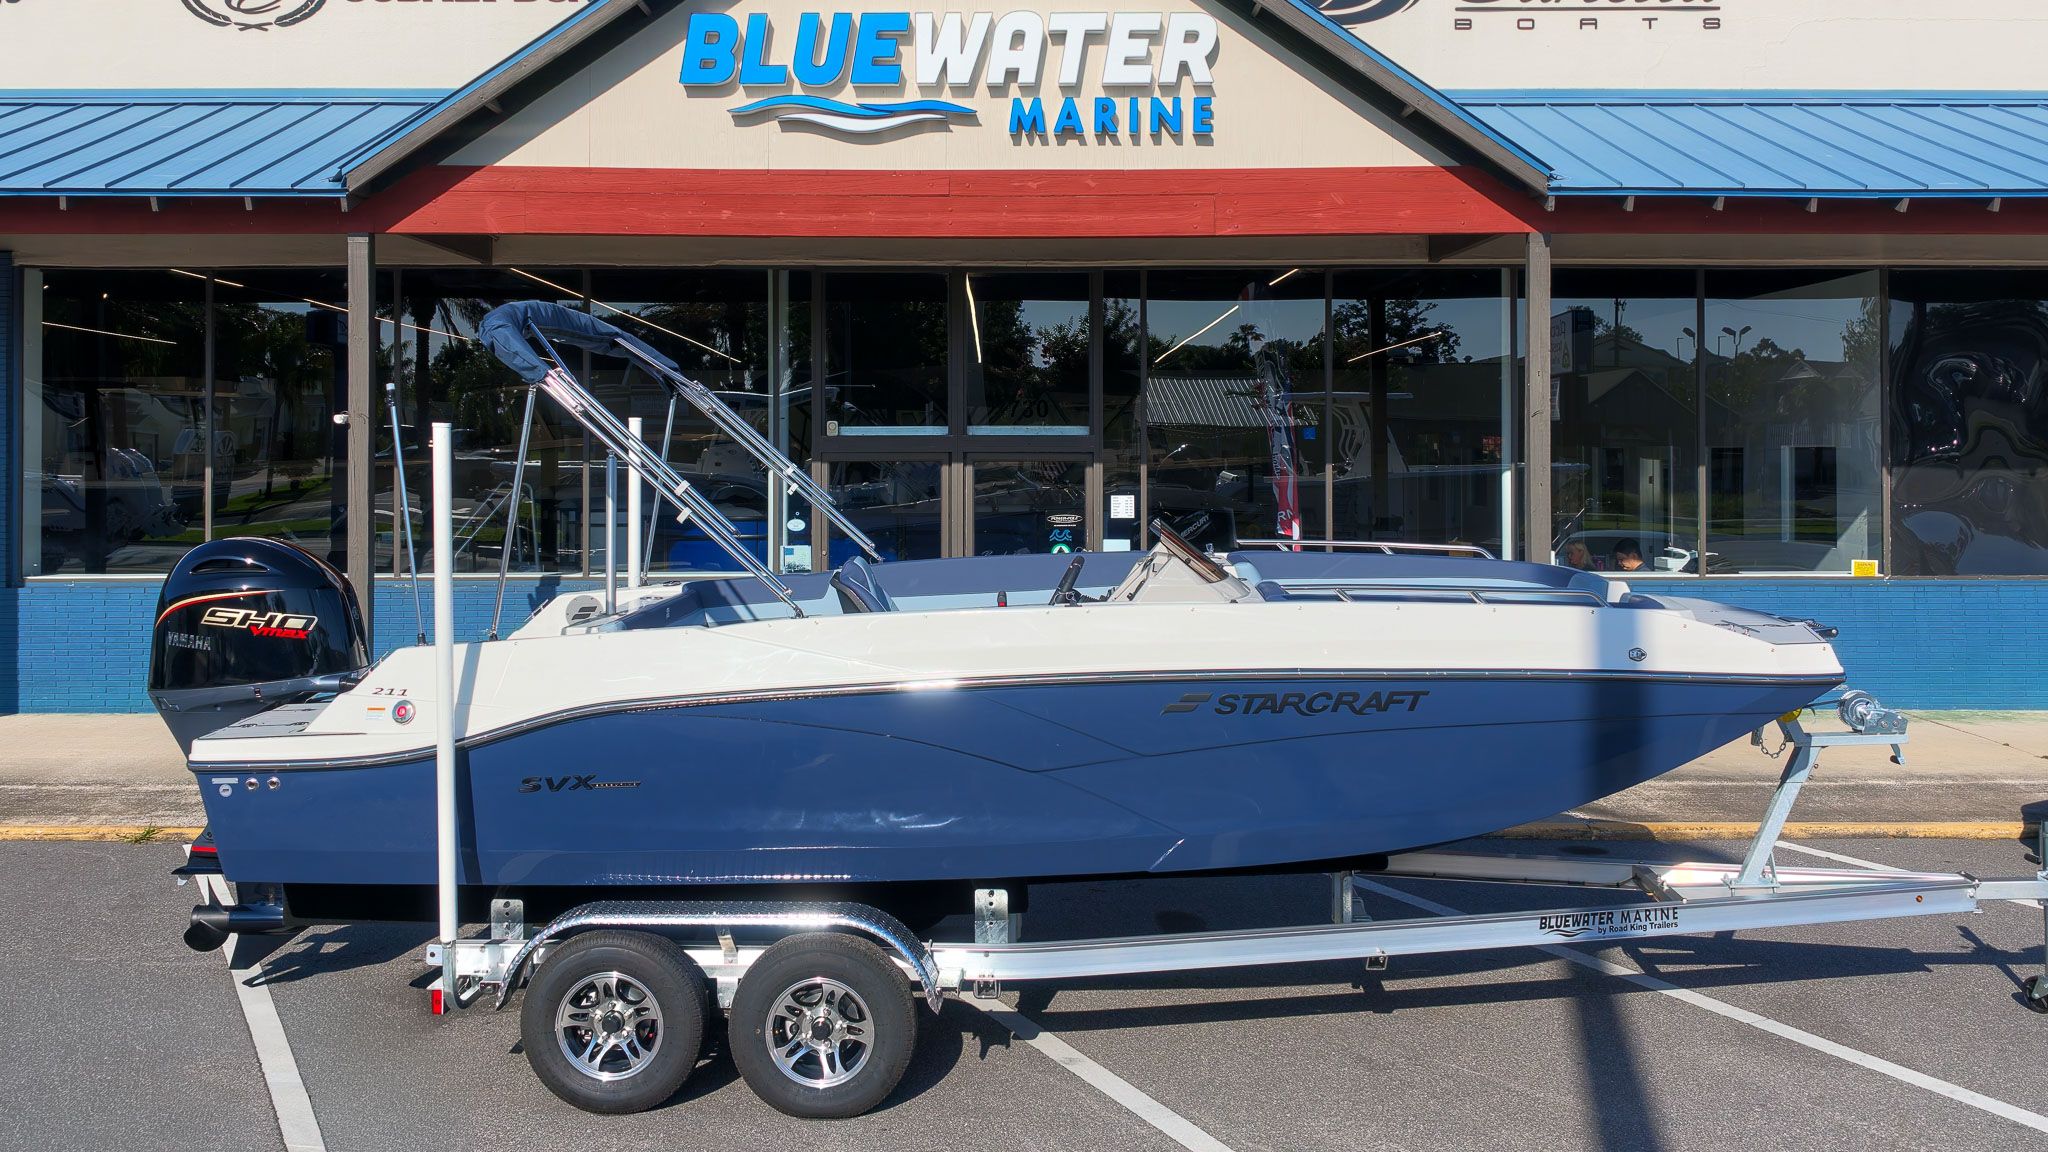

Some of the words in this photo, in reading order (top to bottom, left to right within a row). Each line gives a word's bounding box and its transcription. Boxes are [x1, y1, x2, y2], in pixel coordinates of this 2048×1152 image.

[1454, 17, 1721, 31] BOATS
[678, 12, 1219, 87] BLUEWATER
[1008, 96, 1214, 136] MARINE
[201, 607, 319, 631] SHO
[168, 631, 212, 651] YAMAHA
[372, 687, 408, 697] 211
[1214, 690, 1431, 716] STARCRAFT
[519, 775, 596, 793] SVX
[1539, 911, 1614, 930] BLUEWATER
[1620, 907, 1679, 924] MARINE
[1609, 925, 1628, 933] Road
[1630, 923, 1648, 932] King
[1650, 921, 1679, 930] Trailers
